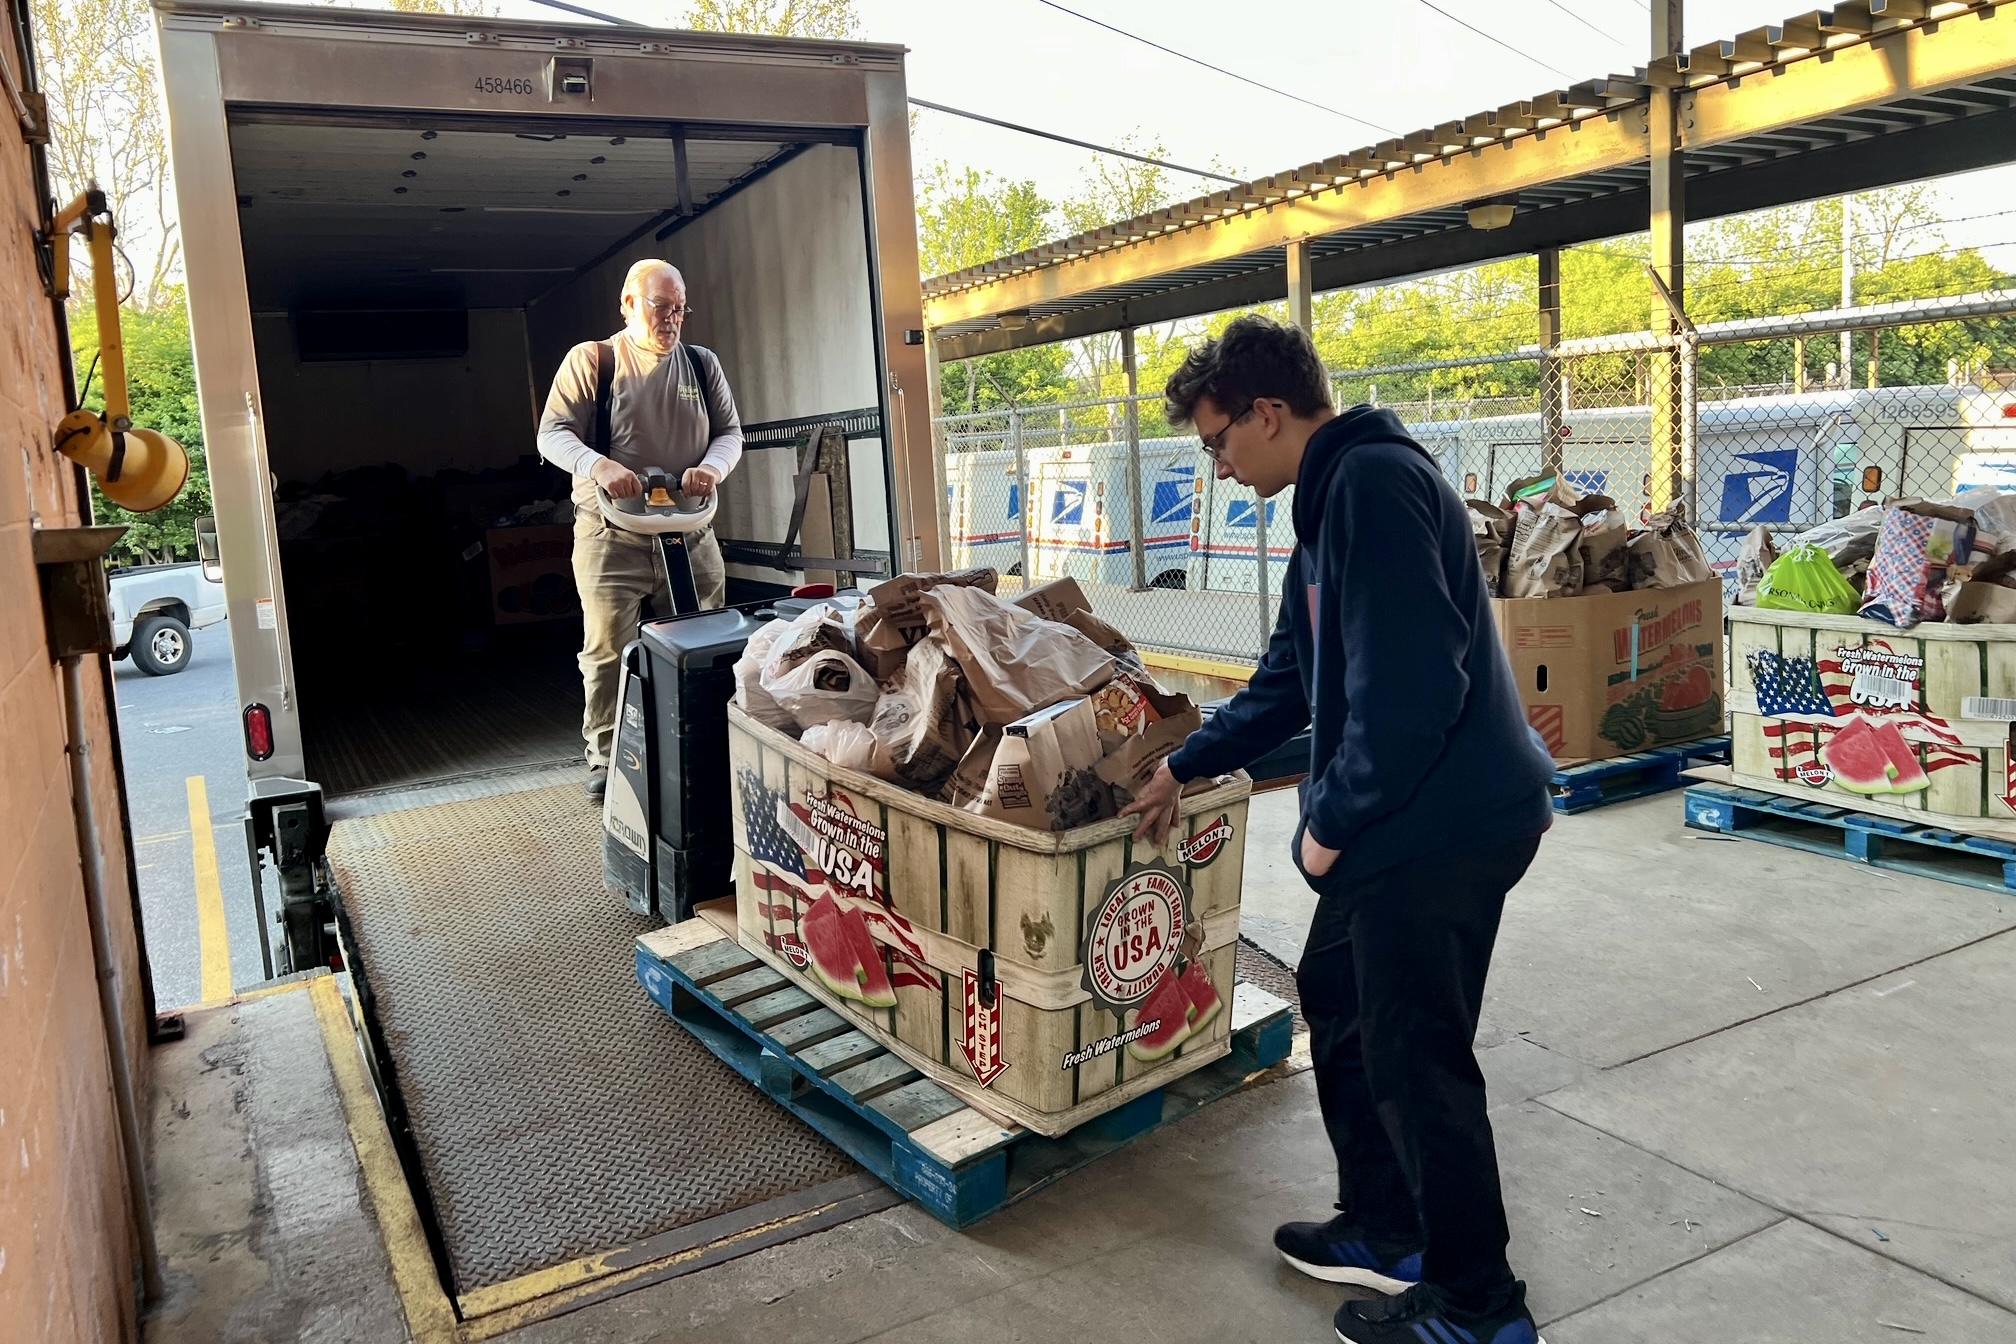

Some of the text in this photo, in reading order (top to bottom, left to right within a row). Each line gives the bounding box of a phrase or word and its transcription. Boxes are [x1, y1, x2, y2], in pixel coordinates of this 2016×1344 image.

[474, 77, 533, 95] 458466
[1615, 600, 1702, 661] WTERMELONS
[1837, 647, 1923, 666] Fresh Watermelons
[1842, 658, 1917, 681] Grown in the
[806, 791, 886, 840] Fresh Watermelons
[811, 808, 880, 858] Grown in the
[819, 838, 874, 897] USA
[1100, 877, 1183, 939] LOCAL FAMILY FARMS
[1118, 899, 1155, 927] GROWN
[1120, 913, 1153, 940] IN THE
[1114, 926, 1162, 970] USA
[1094, 953, 1165, 996] FRESH QUALITY
[1062, 1019, 1161, 1069] Fresh Watermelons
